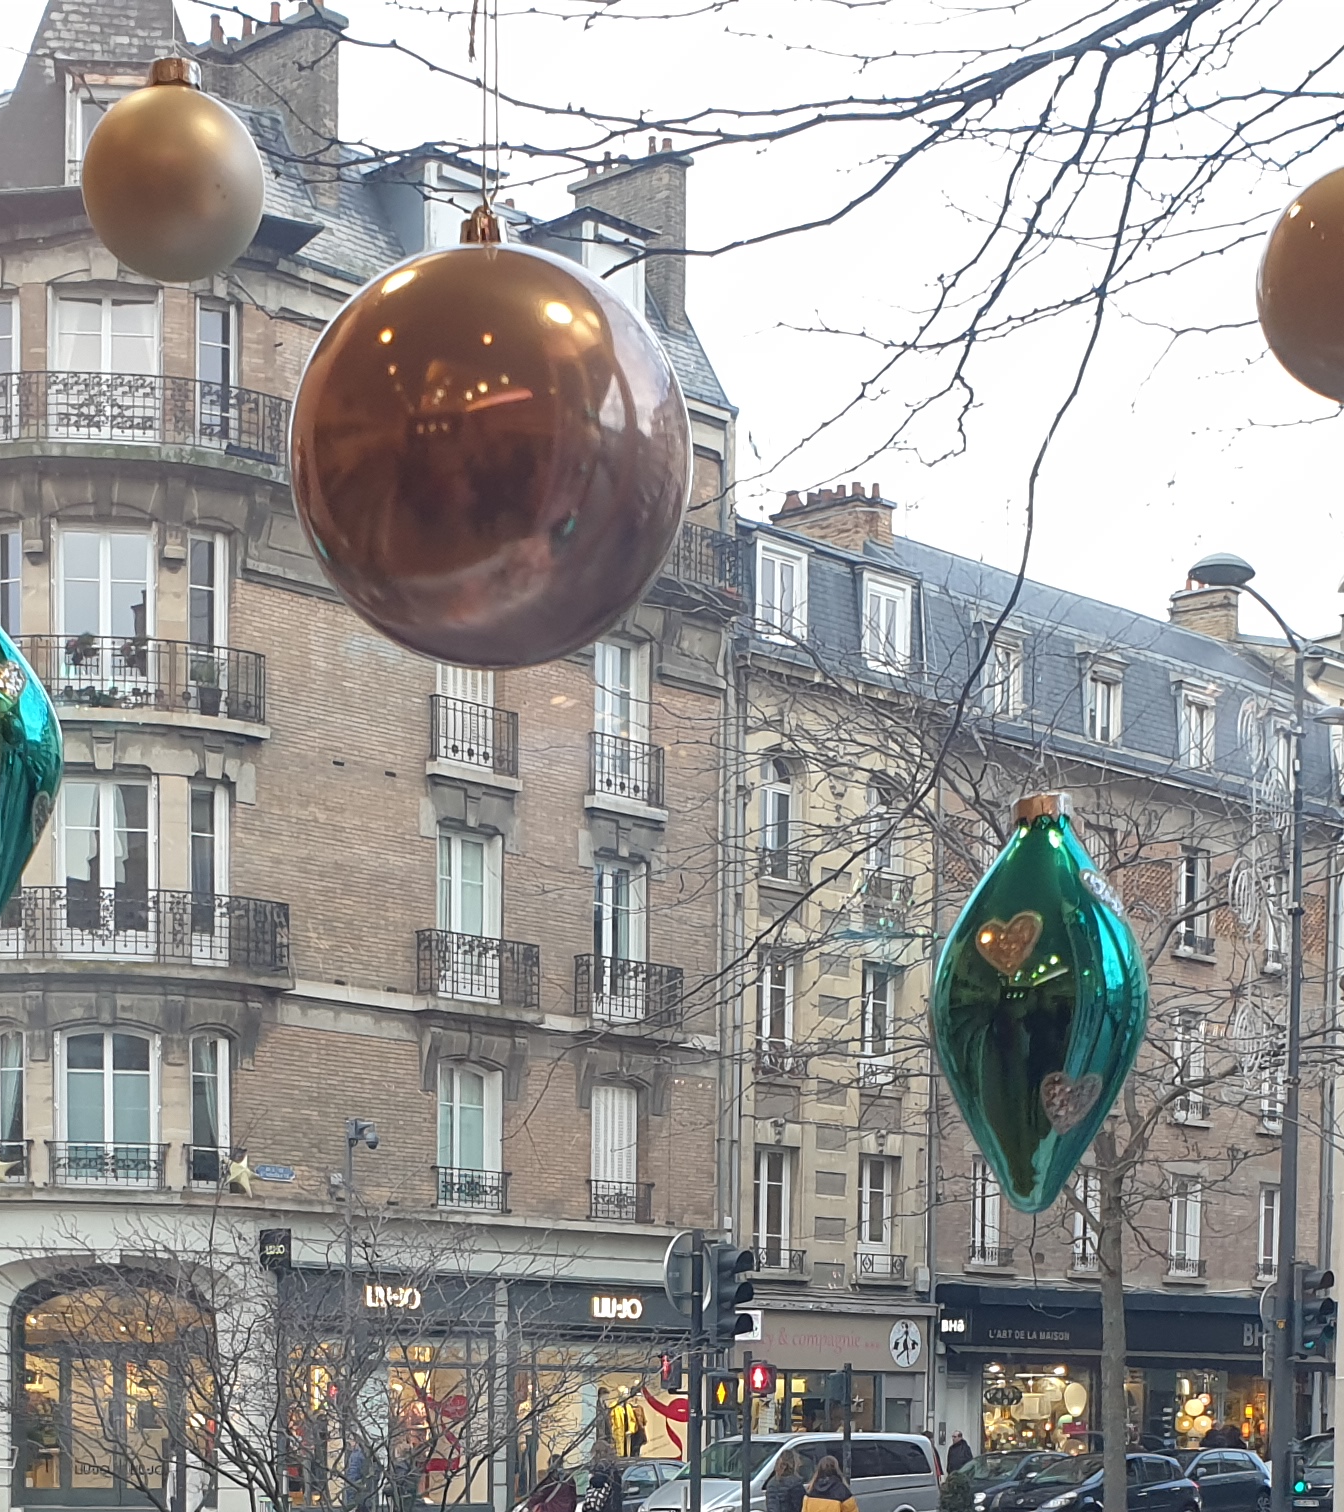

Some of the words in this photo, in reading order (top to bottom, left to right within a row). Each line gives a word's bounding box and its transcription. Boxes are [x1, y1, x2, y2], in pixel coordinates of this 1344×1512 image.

[778, 1327, 788, 1345] &
[792, 1329, 860, 1355] compagnie
[988, 1329, 1013, 1339] L'ART
[1015, 1330, 1026, 1339] DE
[1027, 1330, 1038, 1340] LA
[1039, 1331, 1070, 1341] MAISON
[1243, 1322, 1264, 1347] BH
